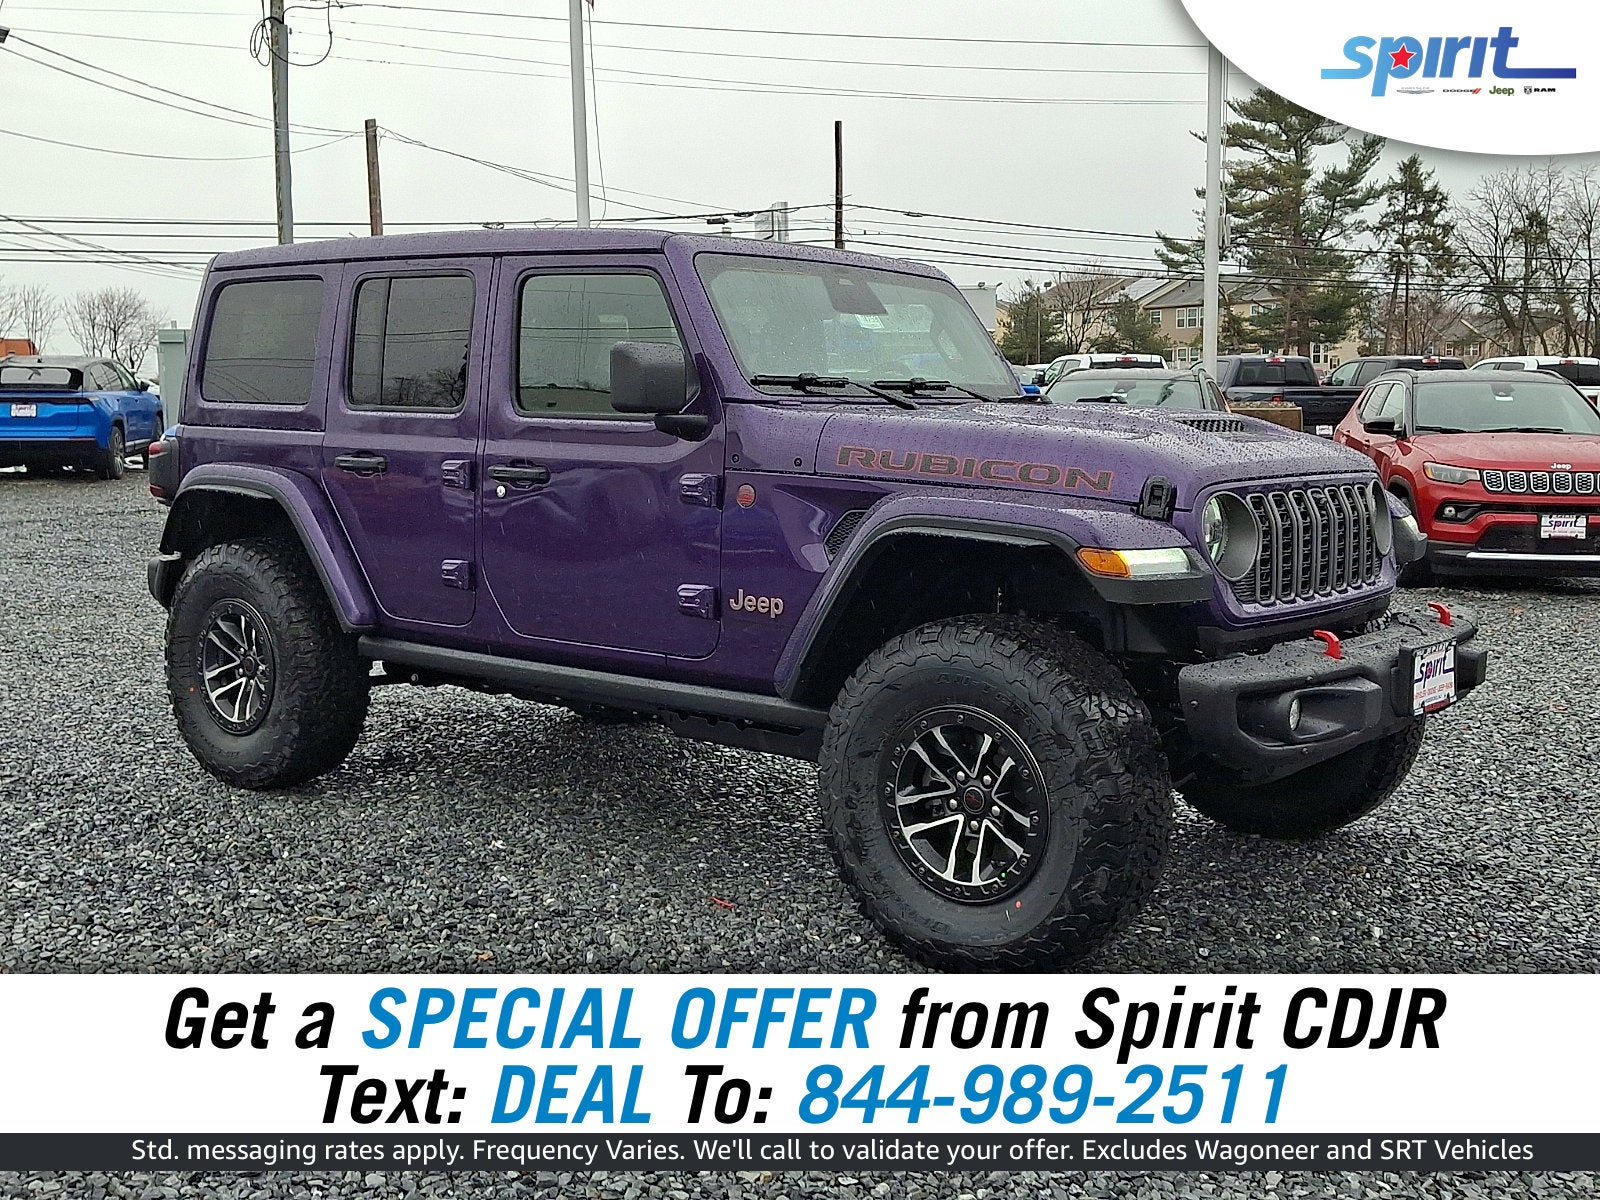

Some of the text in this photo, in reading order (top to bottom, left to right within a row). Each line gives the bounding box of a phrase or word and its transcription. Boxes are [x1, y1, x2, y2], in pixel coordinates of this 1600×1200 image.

[836, 446, 1114, 493] RUBICON
[1550, 462, 1572, 471] Jeep
[729, 588, 785, 619] Jeep
